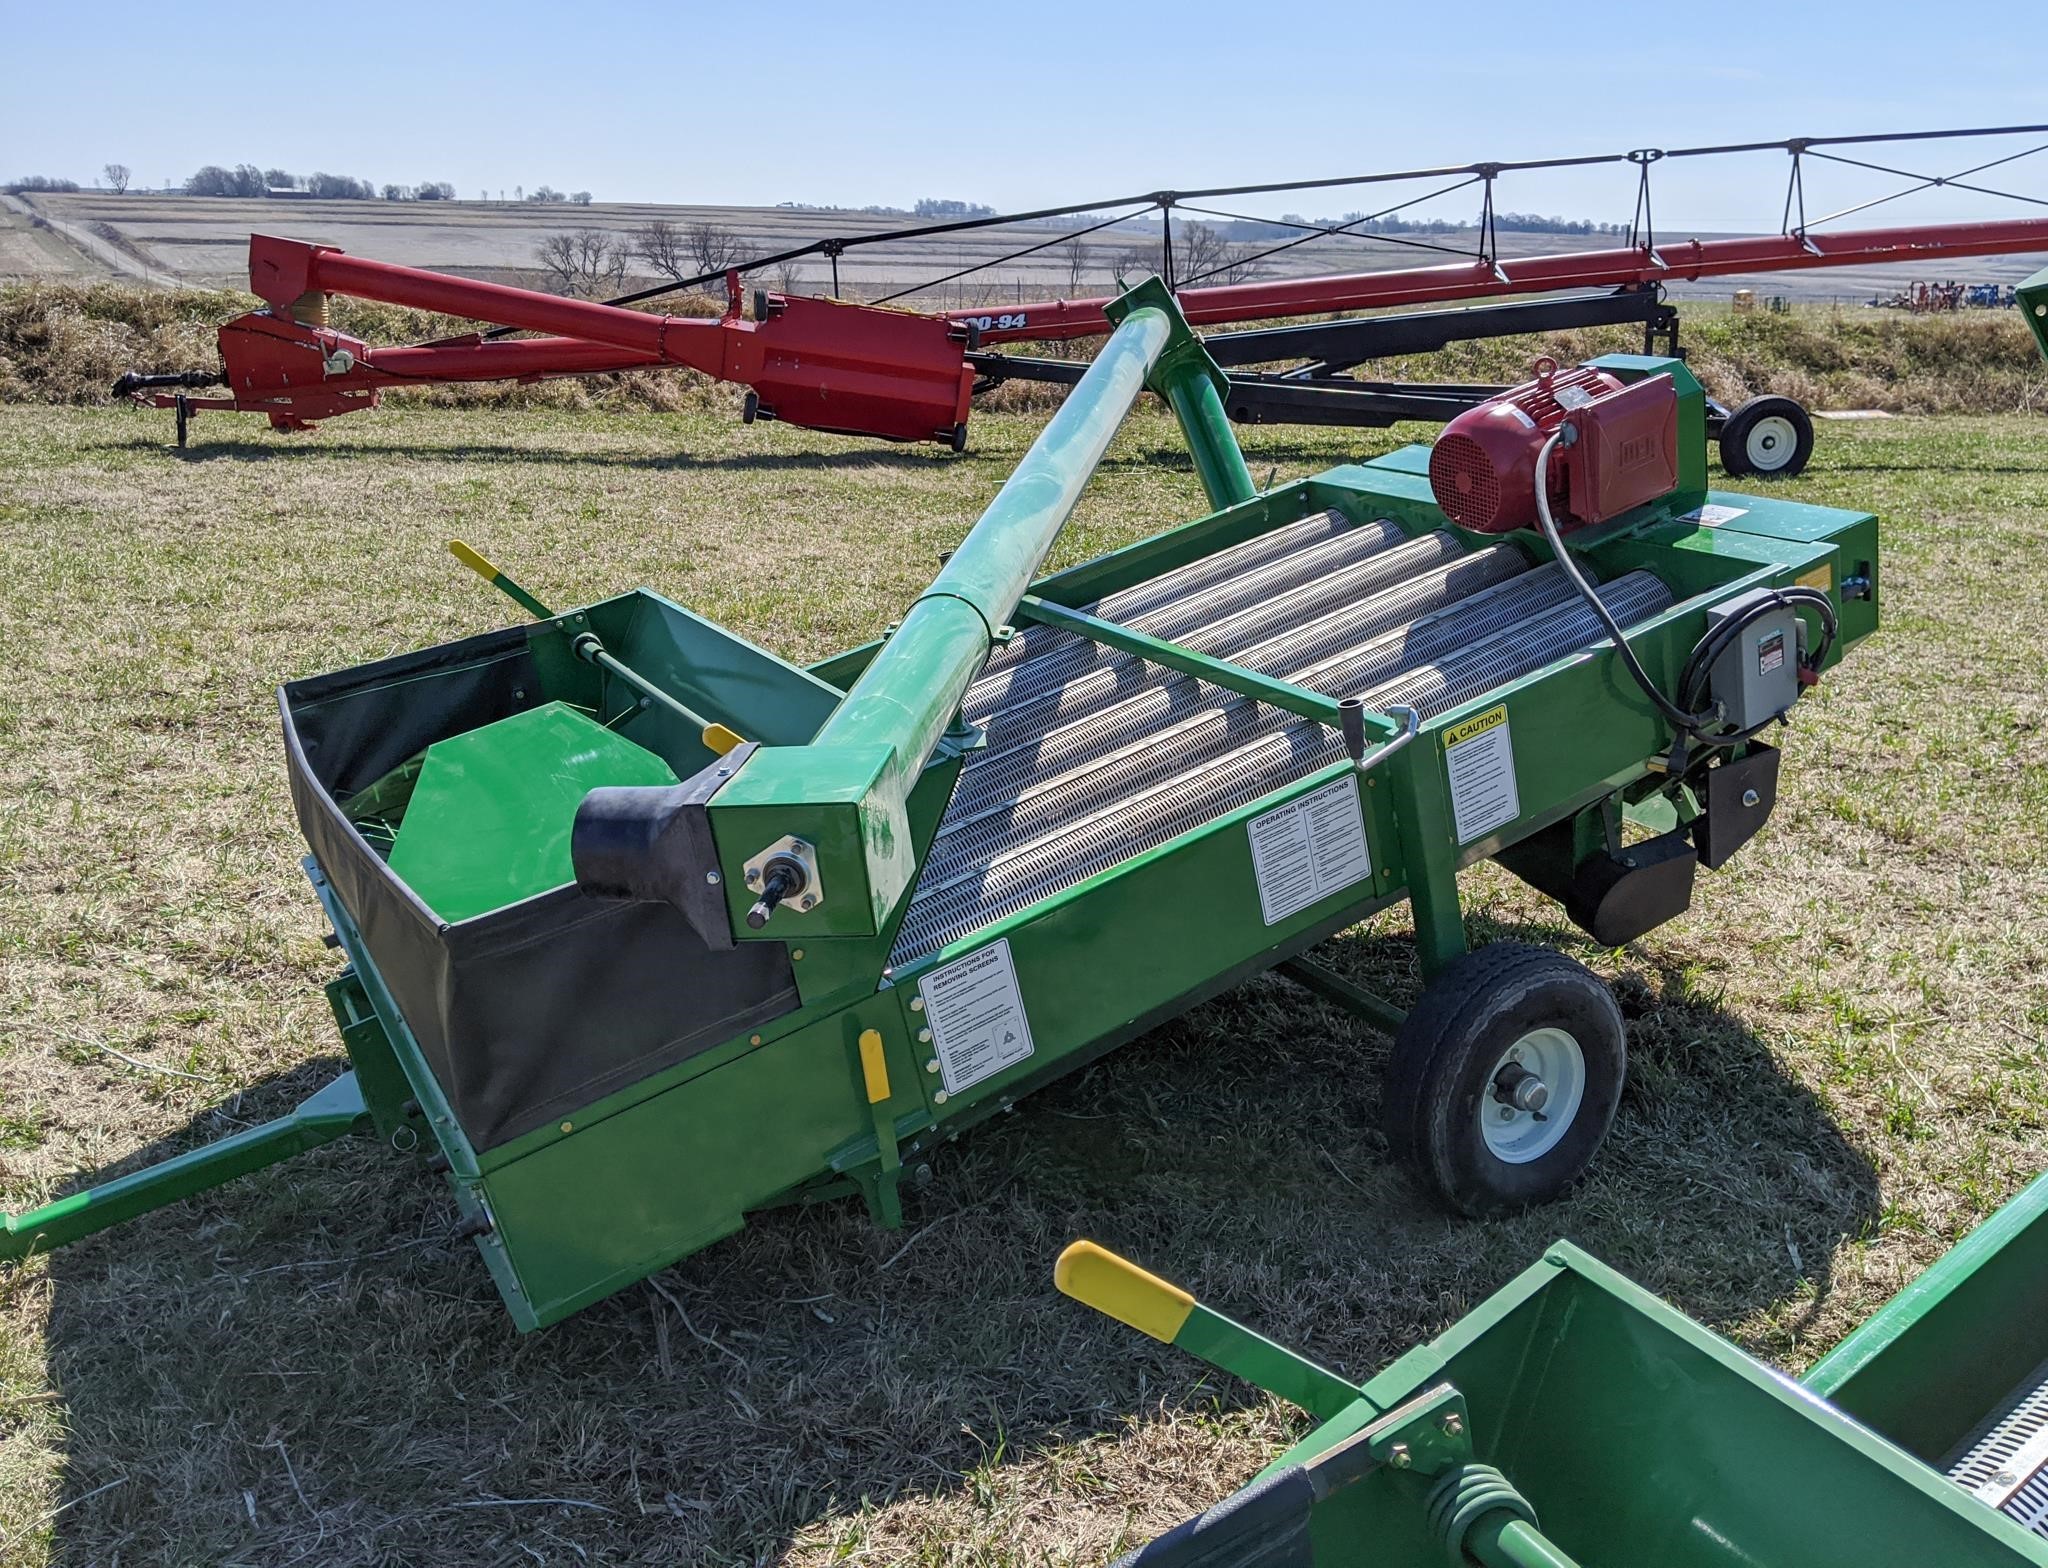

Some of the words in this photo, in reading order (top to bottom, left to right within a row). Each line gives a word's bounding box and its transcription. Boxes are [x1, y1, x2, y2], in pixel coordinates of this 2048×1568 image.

[1460, 711, 1502, 738] CAUTION
[1256, 806, 1296, 829] OPERATING
[1298, 781, 1349, 810] INSTRUCTIONS
[932, 955, 981, 983] INSTRUCTIONS
[981, 948, 996, 960] FOR
[933, 971, 968, 991] REMOVING
[969, 956, 999, 974] SCREENS
